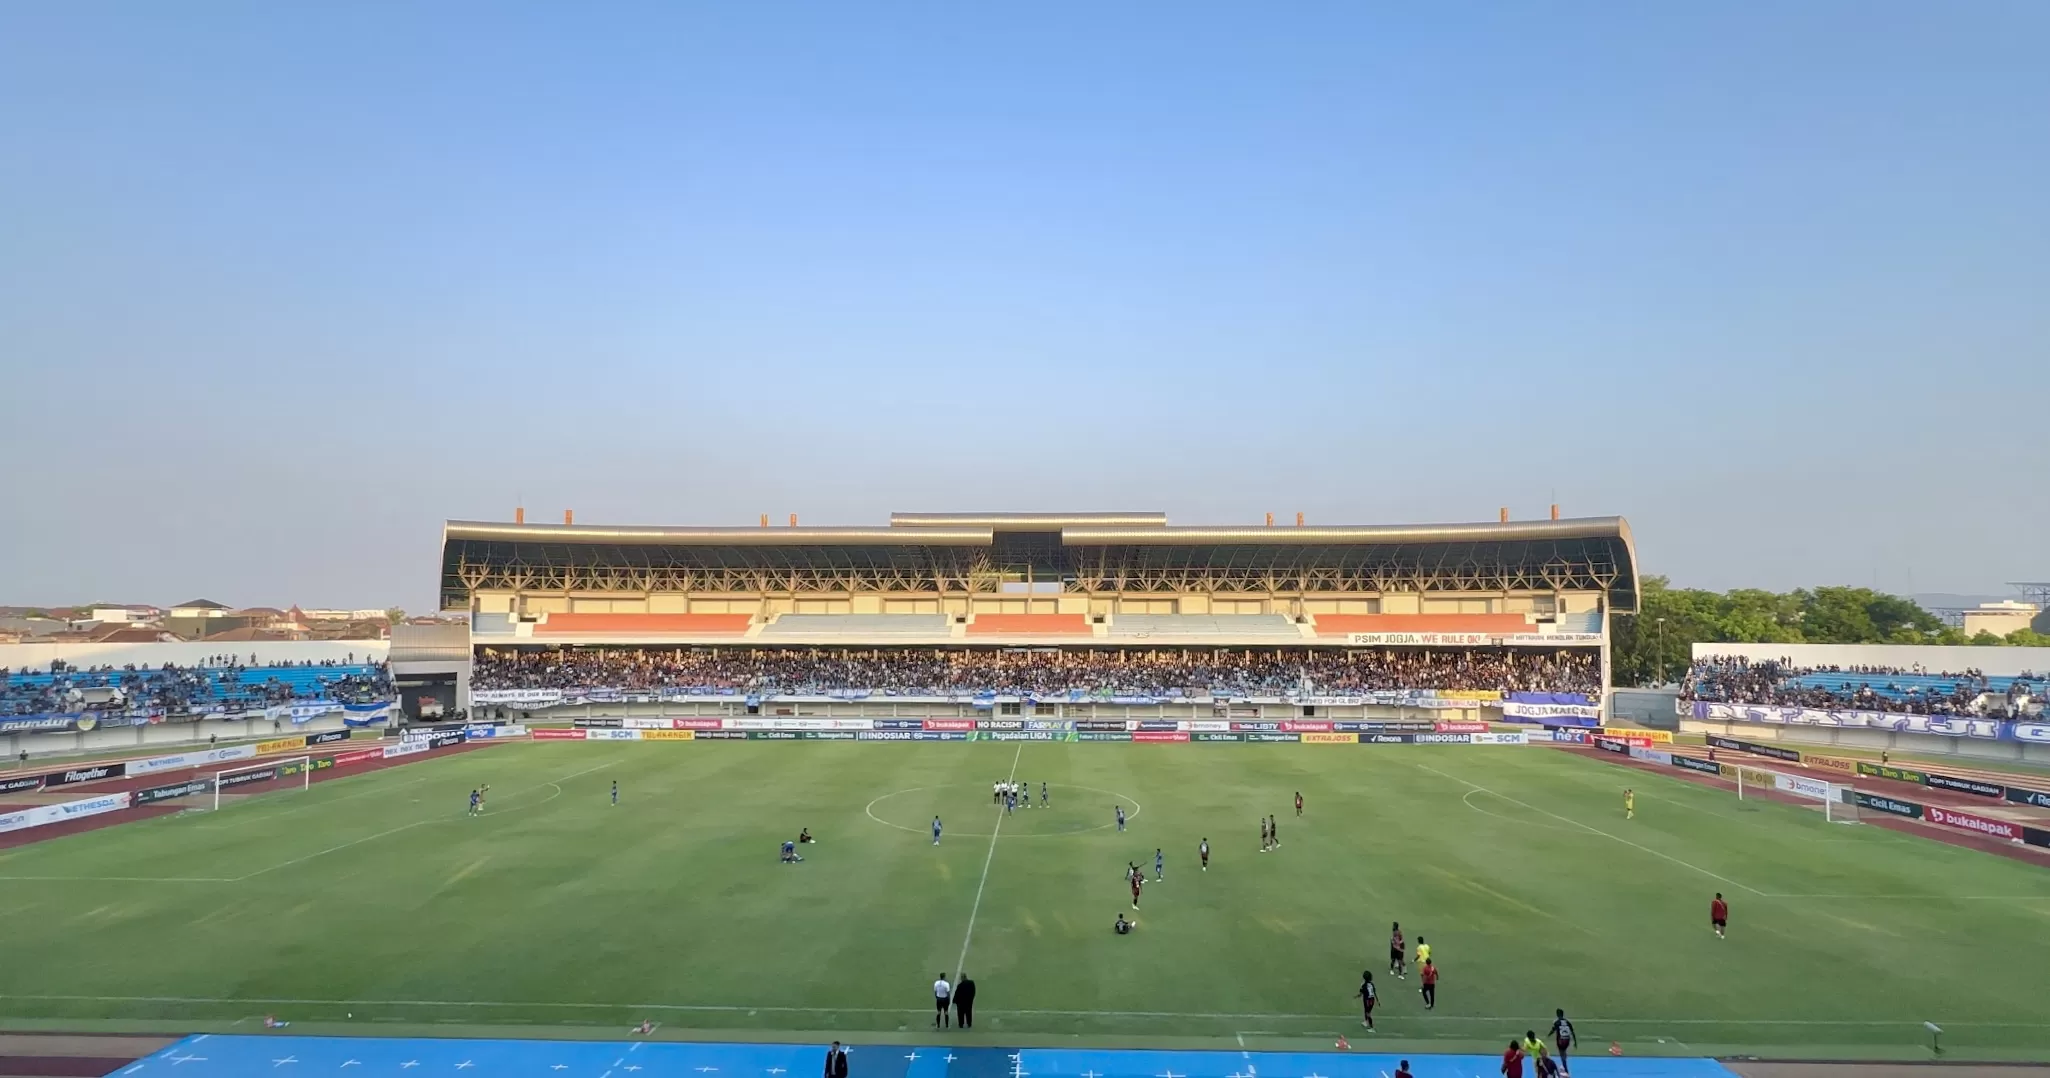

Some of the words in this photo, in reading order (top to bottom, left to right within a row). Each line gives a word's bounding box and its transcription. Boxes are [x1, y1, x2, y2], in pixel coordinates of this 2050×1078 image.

[1355, 634, 1381, 643] PSIM
[1385, 634, 1419, 644] JOGJA,
[1421, 635, 1439, 643] WE
[1441, 635, 1465, 644] RULE
[611, 730, 633, 738] SCM
[868, 732, 911, 740] INDOSIAR
[1425, 734, 1470, 742] INDOSIAR
[1496, 734, 1520, 742] SCM
[153, 786, 187, 798] Tabungan
[187, 783, 206, 793] Emas
[1888, 801, 1911, 814] Emas
[1946, 814, 2012, 837] bukalapak
